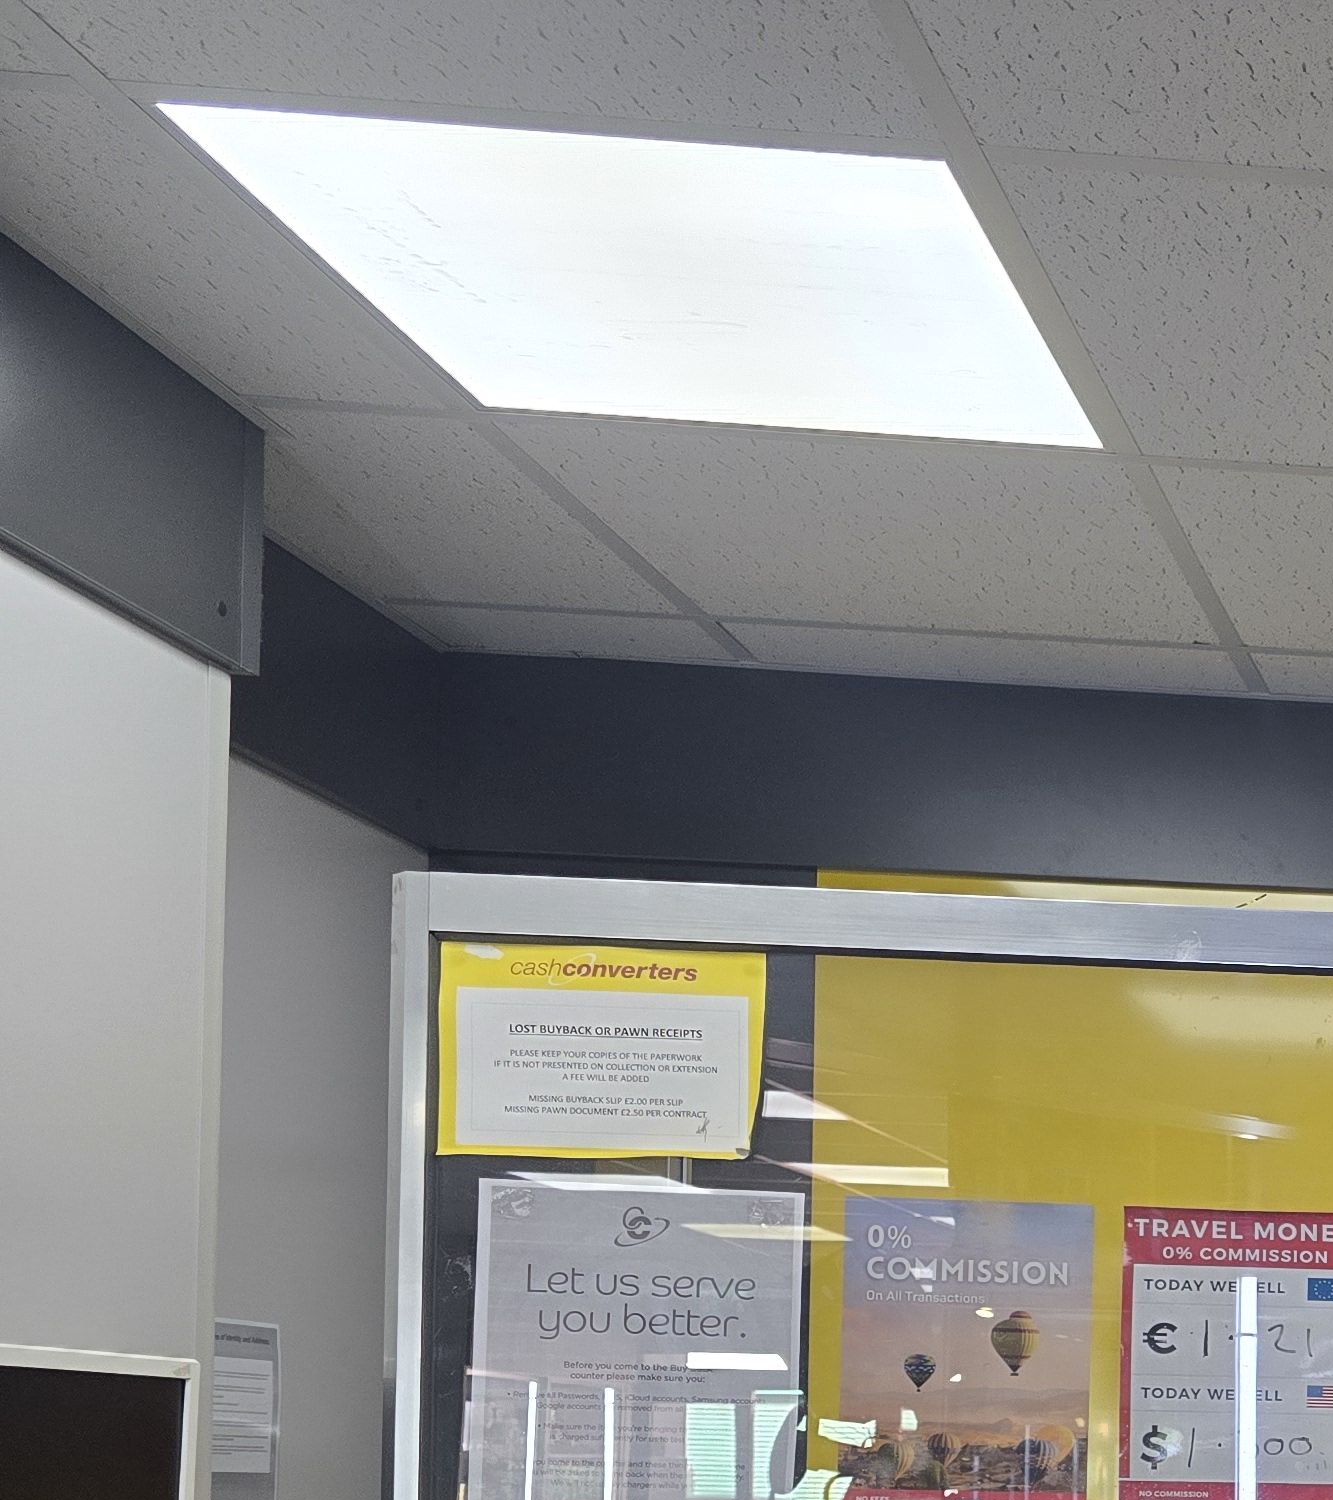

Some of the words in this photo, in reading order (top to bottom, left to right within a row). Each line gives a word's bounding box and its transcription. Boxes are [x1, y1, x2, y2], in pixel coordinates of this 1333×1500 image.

[510, 957, 697, 982] cashconverters
[509, 1024, 538, 1034] LOST
[538, 1025, 593, 1037] BUYBACK
[594, 1026, 613, 1036] OR
[612, 1027, 651, 1037] PAWN
[650, 1028, 703, 1038] RECEIPTS
[510, 1049, 540, 1058] PLEASE
[541, 1050, 562, 1058] KEEP
[563, 1051, 587, 1059] YOUR
[588, 1051, 618, 1060] COPIES
[619, 1052, 631, 1060] OF
[650, 1053, 702, 1062] PAPERWORK
[504, 1105, 540, 1114] MISSING
[541, 1107, 568, 1115] PAWN
[569, 1107, 619, 1116] DOCUMENT
[621, 1108, 644, 1117] £2.50
[645, 1109, 662, 1117] PER
[662, 1110, 708, 1119] CONTRACT
[868, 1224, 912, 1248] 0%
[1134, 1219, 1243, 1240] TRAVEL
[1162, 1246, 1192, 1259] 0%
[1200, 1248, 1328, 1264] COMMISSION
[866, 1256, 1068, 1286] COMMISSION
[526, 1264, 584, 1294] Let
[596, 1271, 640, 1296] us
[651, 1273, 756, 1300] serve
[1144, 1278, 1204, 1292] TODAY
[1210, 1280, 1237, 1292] WE
[1245, 1282, 1286, 1294] ELL
[866, 1290, 882, 1300] On
[887, 1291, 902, 1301] All
[905, 1291, 985, 1304] Transactions
[538, 1308, 612, 1340] you
[624, 1304, 746, 1338] better.
[564, 1361, 594, 1370] Before
[595, 1362, 612, 1373] you
[652, 1363, 668, 1372] the
[570, 1373, 604, 1382] counter
[606, 1373, 636, 1384] please
[638, 1374, 661, 1382] make
[1141, 1387, 1201, 1400] TODAY
[1208, 1388, 1235, 1400] WE
[1242, 1390, 1282, 1401] ELL
[1138, 1490, 1152, 1498] NO
[1154, 1490, 1208, 1498] COMMISSION
